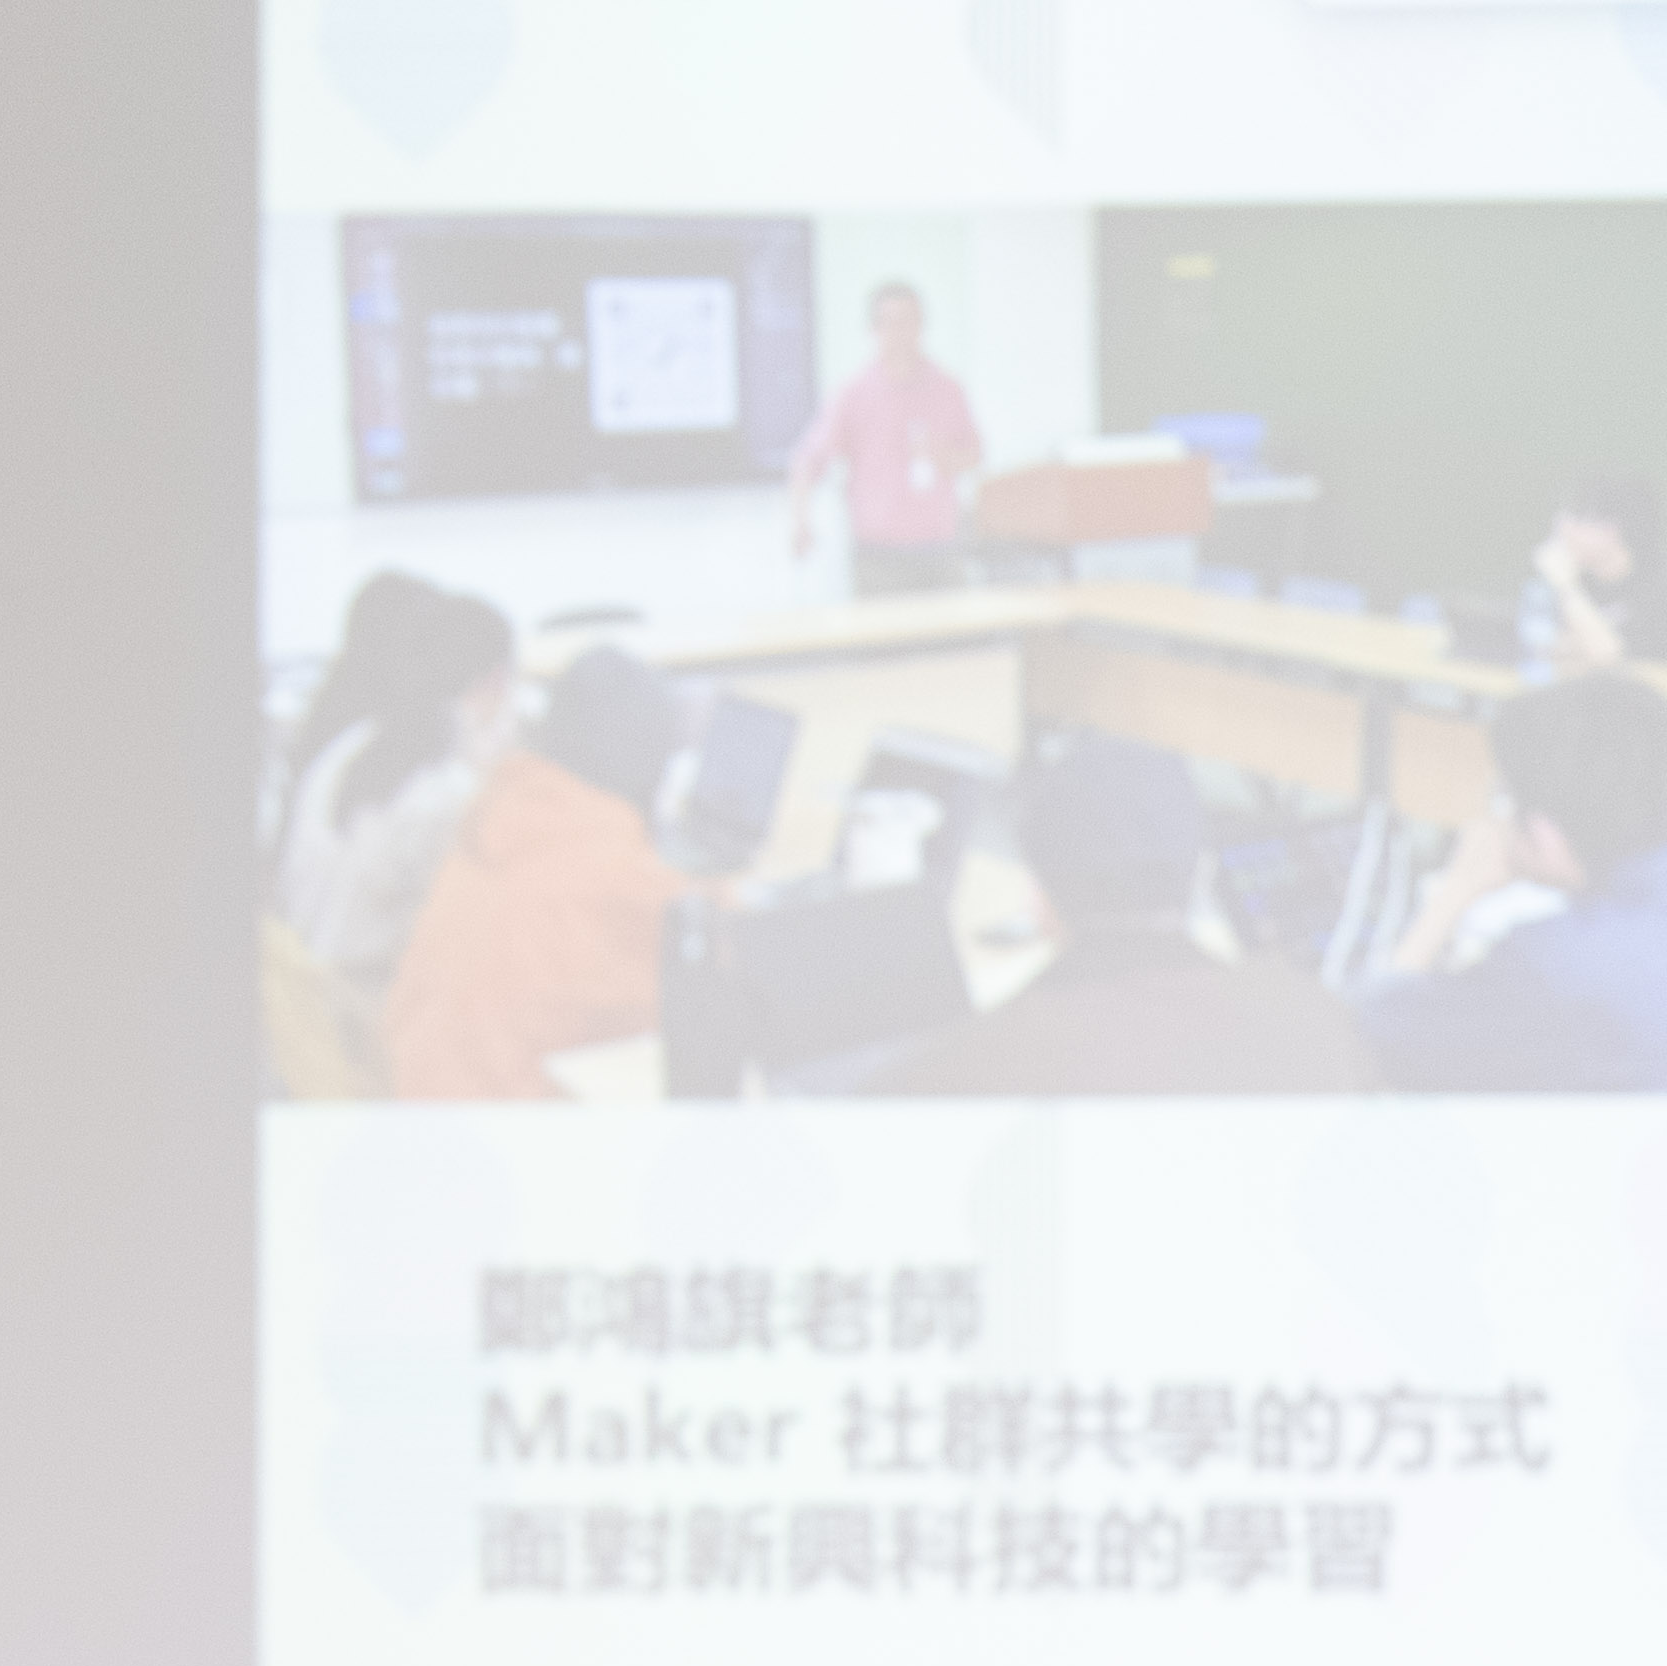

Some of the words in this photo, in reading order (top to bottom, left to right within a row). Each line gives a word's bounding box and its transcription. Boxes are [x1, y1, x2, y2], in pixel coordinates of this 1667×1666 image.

[480, 1384, 802, 1468] Maker
[840, 1380, 1554, 1476] 社群共學的方式
[478, 1499, 1394, 1596] 面對新興科技的學習
